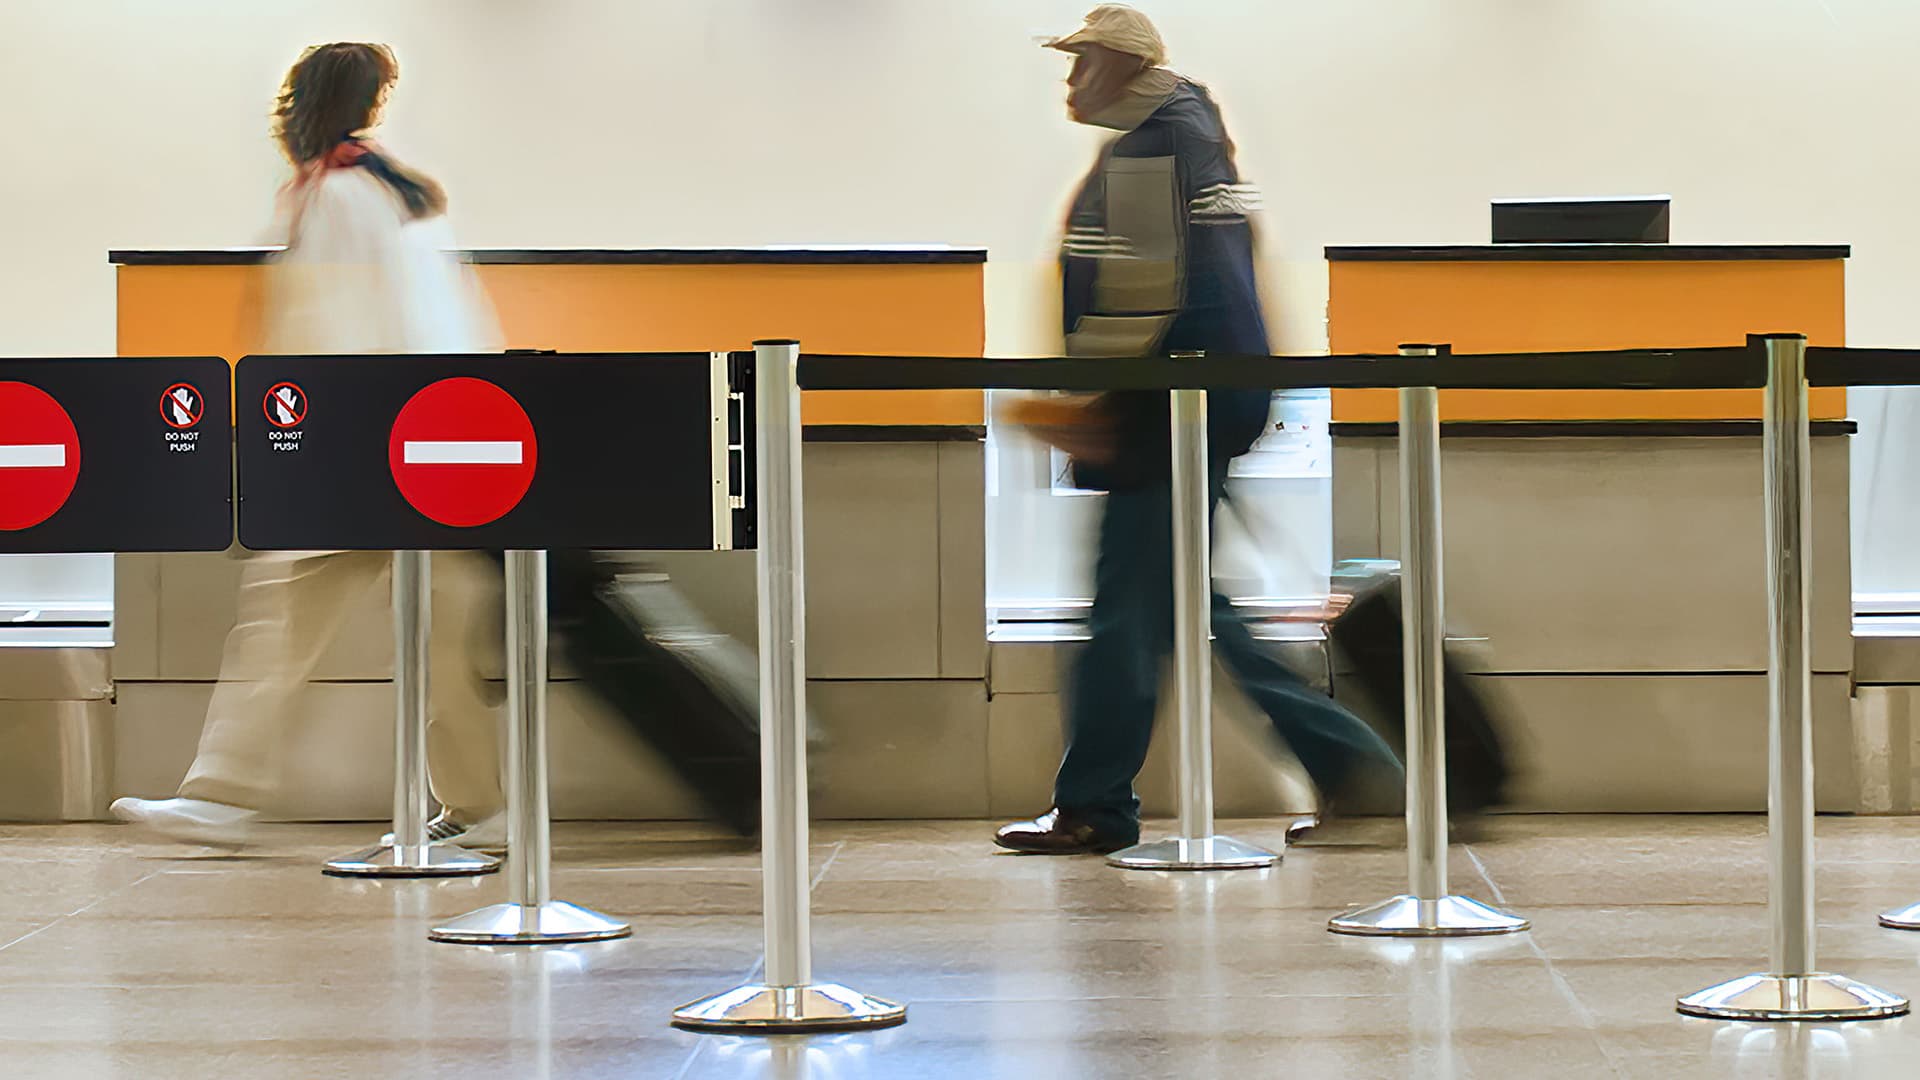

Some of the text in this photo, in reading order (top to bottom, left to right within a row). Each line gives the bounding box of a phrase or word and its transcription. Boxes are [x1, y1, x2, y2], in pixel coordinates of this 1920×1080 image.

[164, 431, 199, 441] DO NOT
[268, 431, 302, 440] DO NOT
[169, 443, 195, 452] PUSH
[273, 442, 299, 451] PUSH
